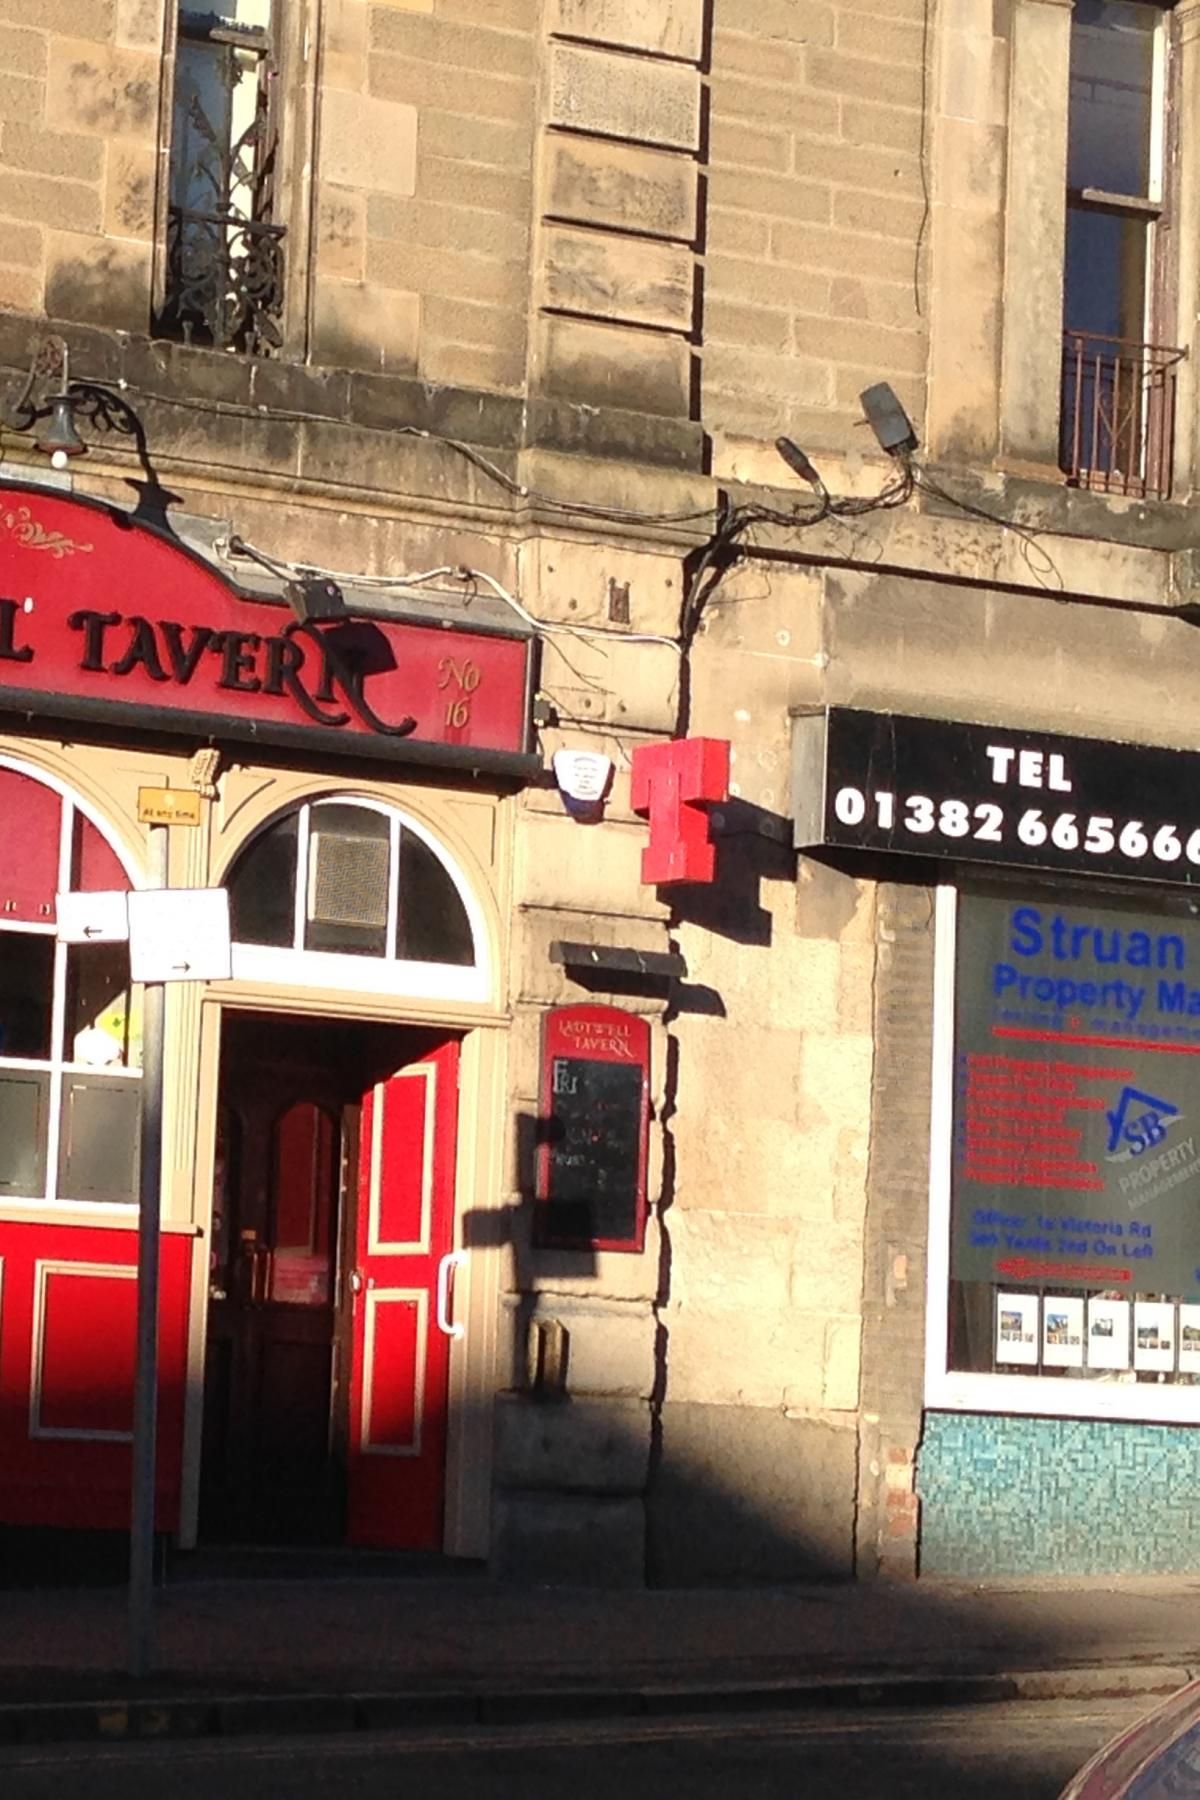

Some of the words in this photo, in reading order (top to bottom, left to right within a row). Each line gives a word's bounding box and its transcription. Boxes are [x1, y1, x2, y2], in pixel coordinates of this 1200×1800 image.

[69, 608, 416, 737] TAVERN
[445, 696, 471, 729] 16
[986, 744, 1072, 792] TEL
[834, 786, 1004, 842] 01382
[1011, 906, 1186, 971] Struan
[992, 962, 1146, 1018] Property
[559, 1019, 632, 1038] LADYWELL
[574, 1034, 636, 1058] TAVERN
[1118, 1136, 1196, 1195] PROPERTY
[1093, 1240, 1117, 1256] On
[1128, 1221, 1152, 1239] Rd
